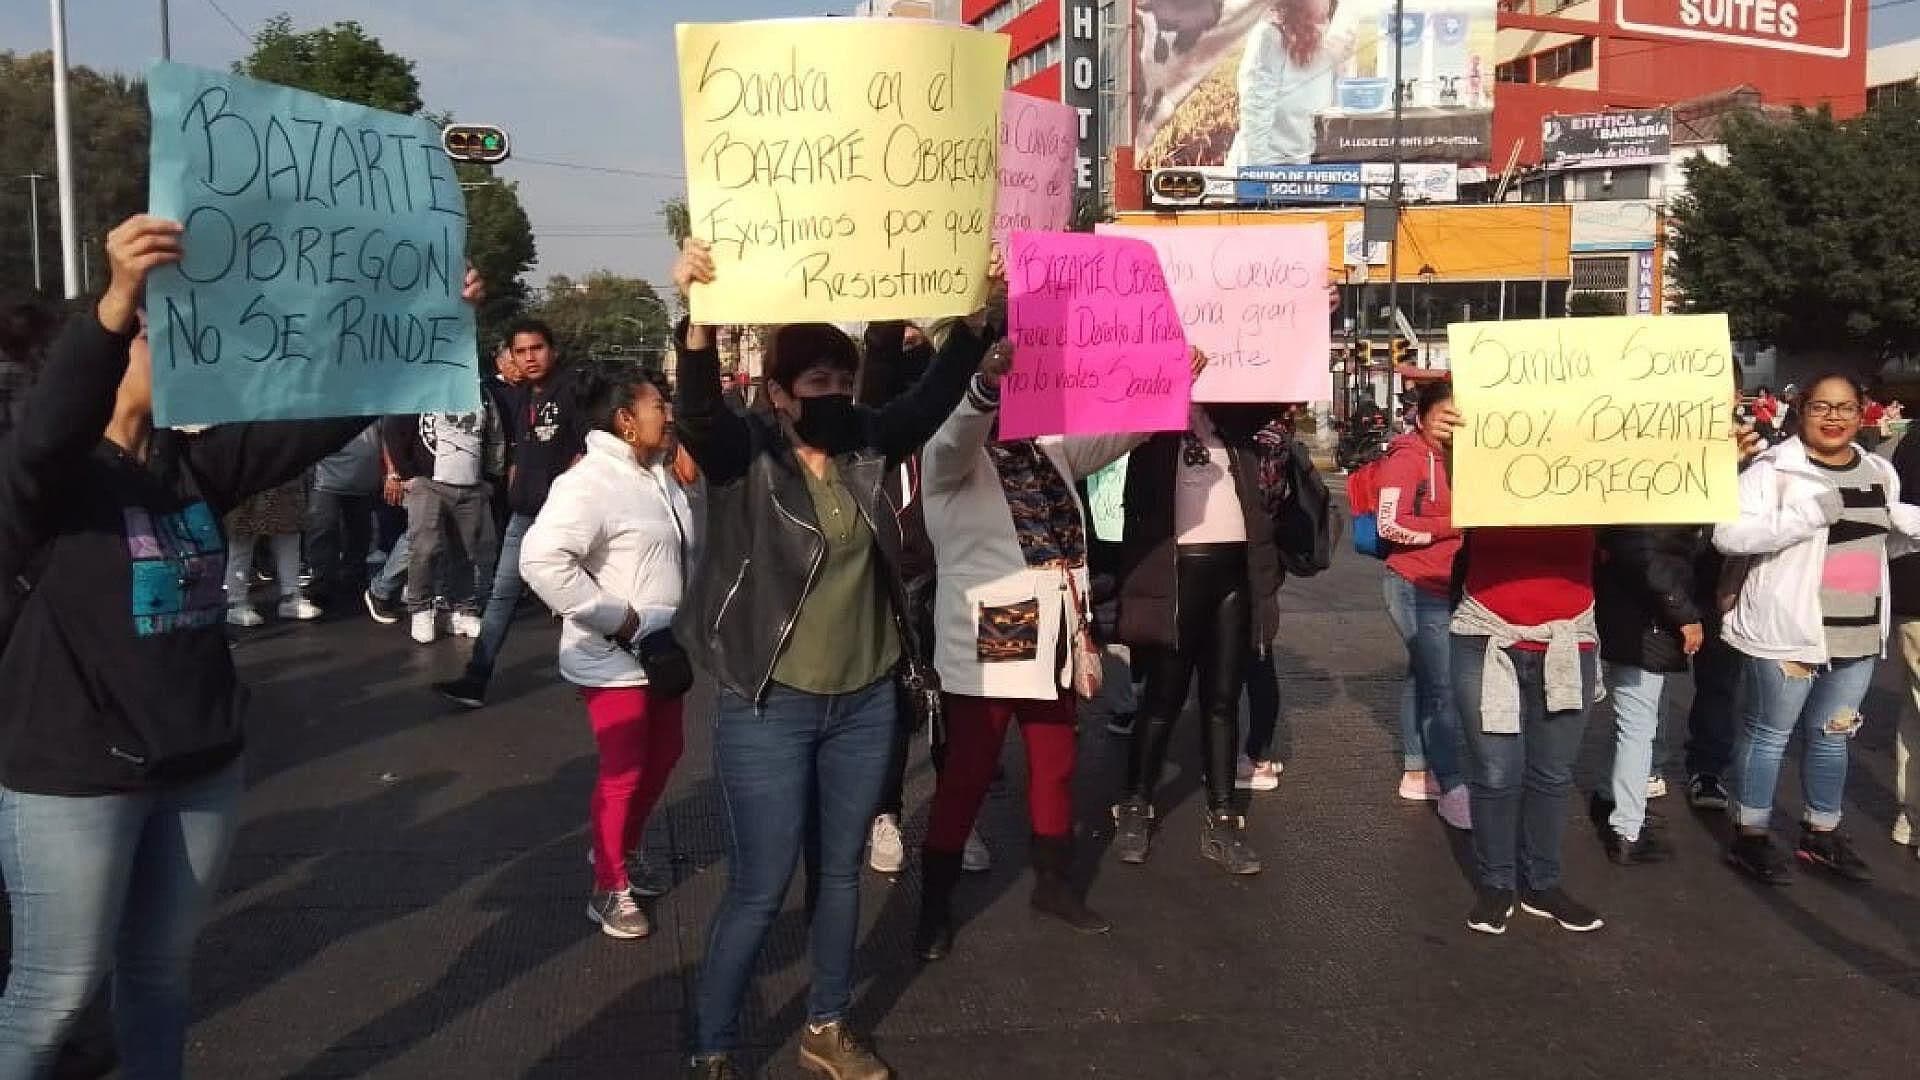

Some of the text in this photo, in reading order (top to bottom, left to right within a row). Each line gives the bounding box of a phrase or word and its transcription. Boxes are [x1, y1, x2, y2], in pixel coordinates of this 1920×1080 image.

[1680, 0, 1798, 38] SUITES
[699, 40, 954, 122] Sandra en el
[1073, 6, 1092, 189] HOTE
[182, 86, 465, 216] BAZARTE
[701, 129, 872, 188] BAZARTE
[1306, 170, 1360, 182] EVENTOS
[176, 206, 450, 297] OBREGON
[700, 192, 984, 260] Existimos por que
[784, 247, 968, 302] Resistimos
[1211, 232, 1310, 291] Cuevas
[327, 295, 469, 368] RINDE
[1470, 326, 1726, 389] Sandra Somos
[1474, 394, 1730, 450] 100% BAZARTE
[1502, 446, 1709, 504] OBREGÓN
